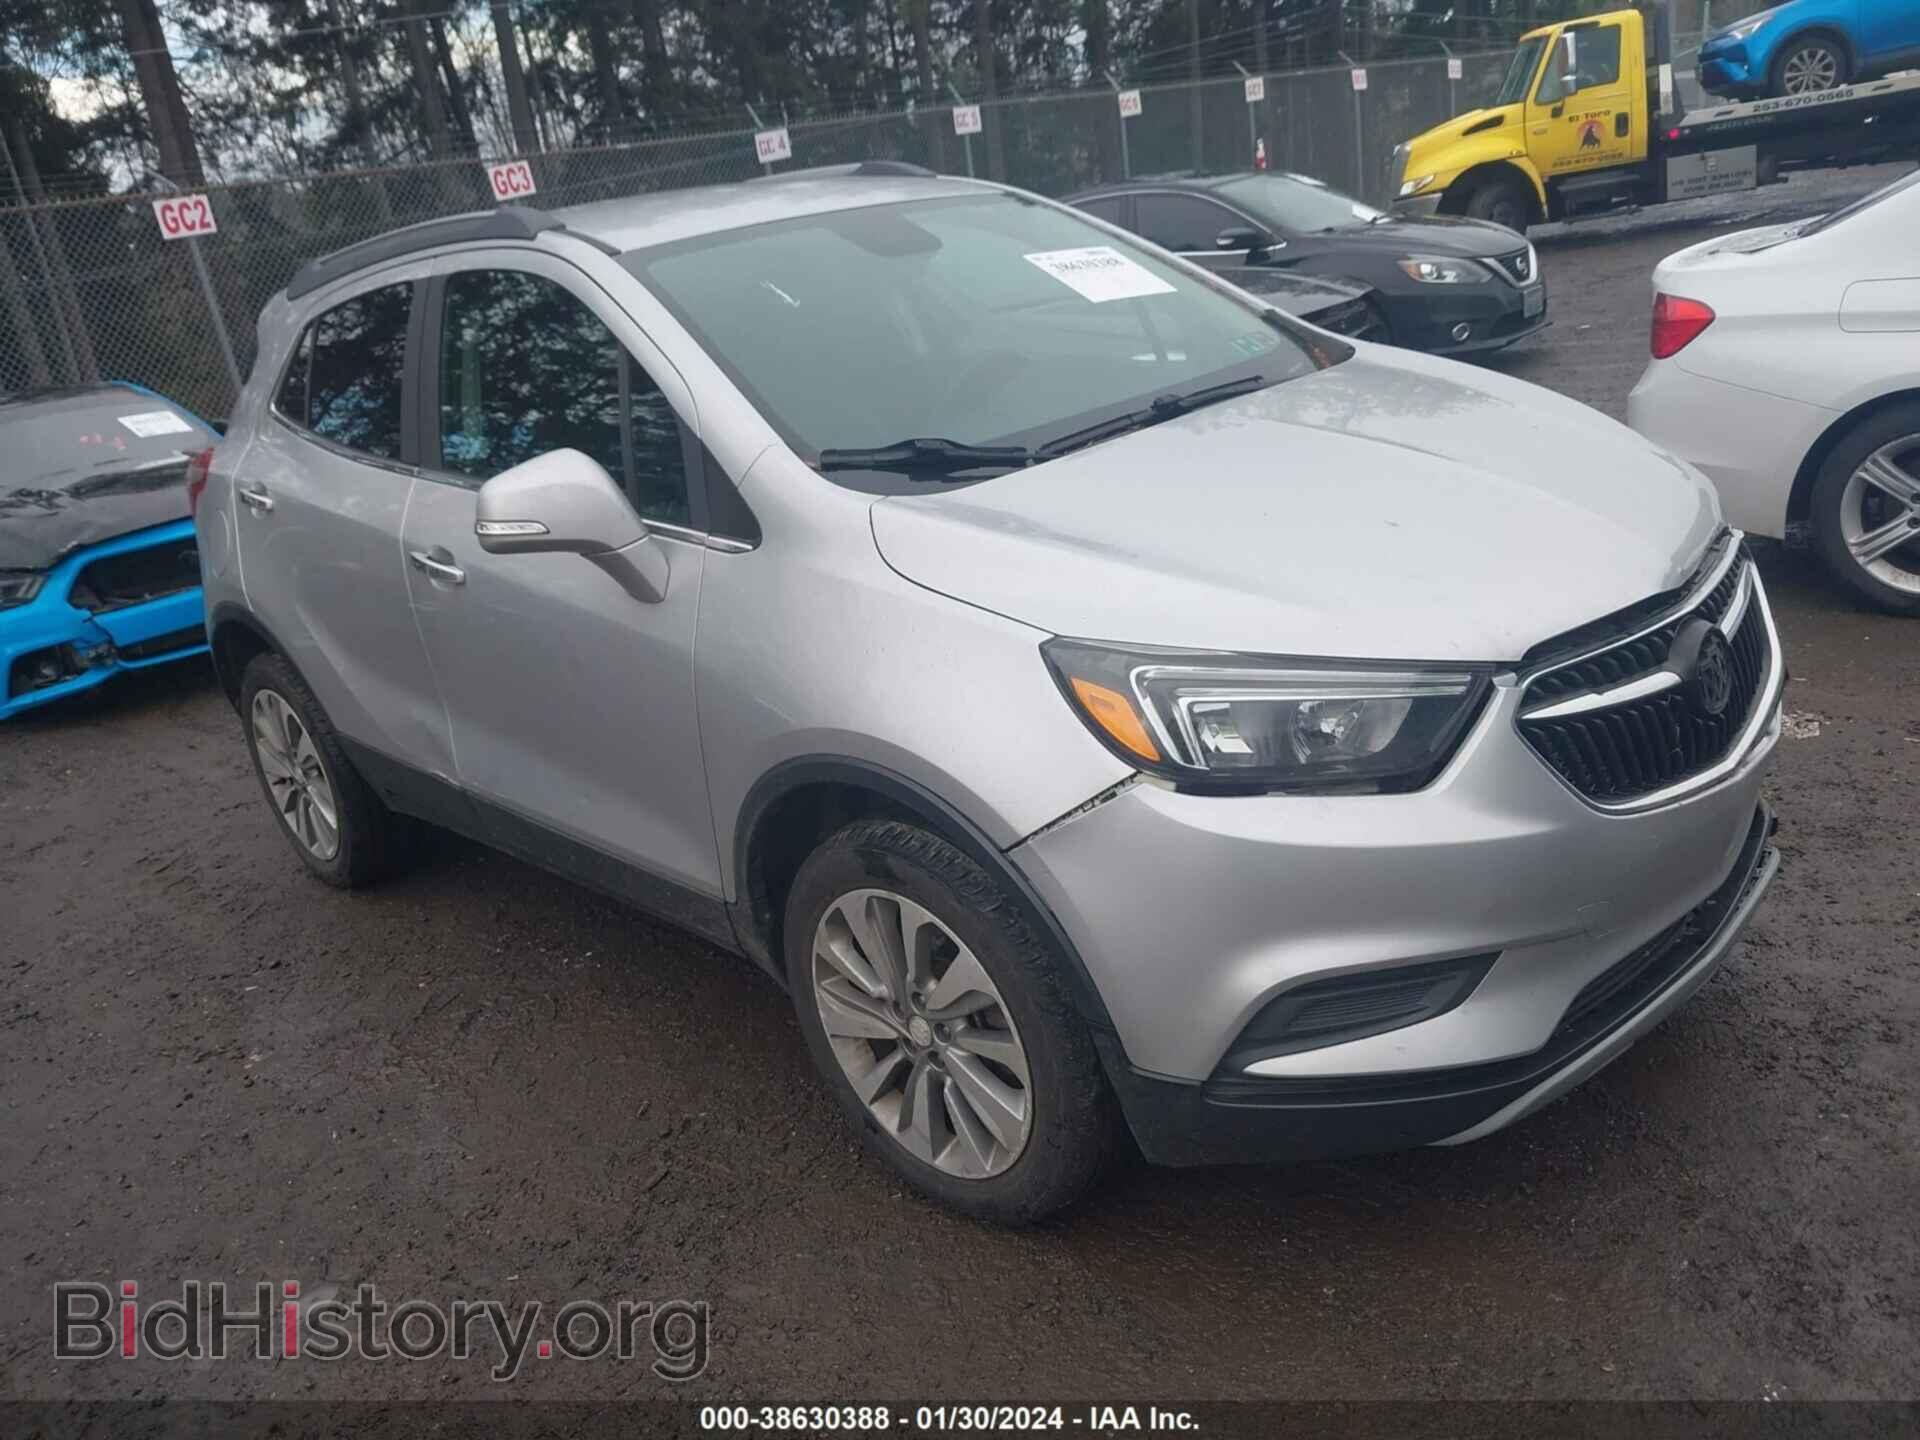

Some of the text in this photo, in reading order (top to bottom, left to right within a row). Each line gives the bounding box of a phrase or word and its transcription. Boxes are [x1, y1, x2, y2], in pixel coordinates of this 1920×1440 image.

[1752, 90, 1855, 113] 253-670-0565
[493, 163, 532, 197] GC3
[161, 197, 213, 236] GC2
